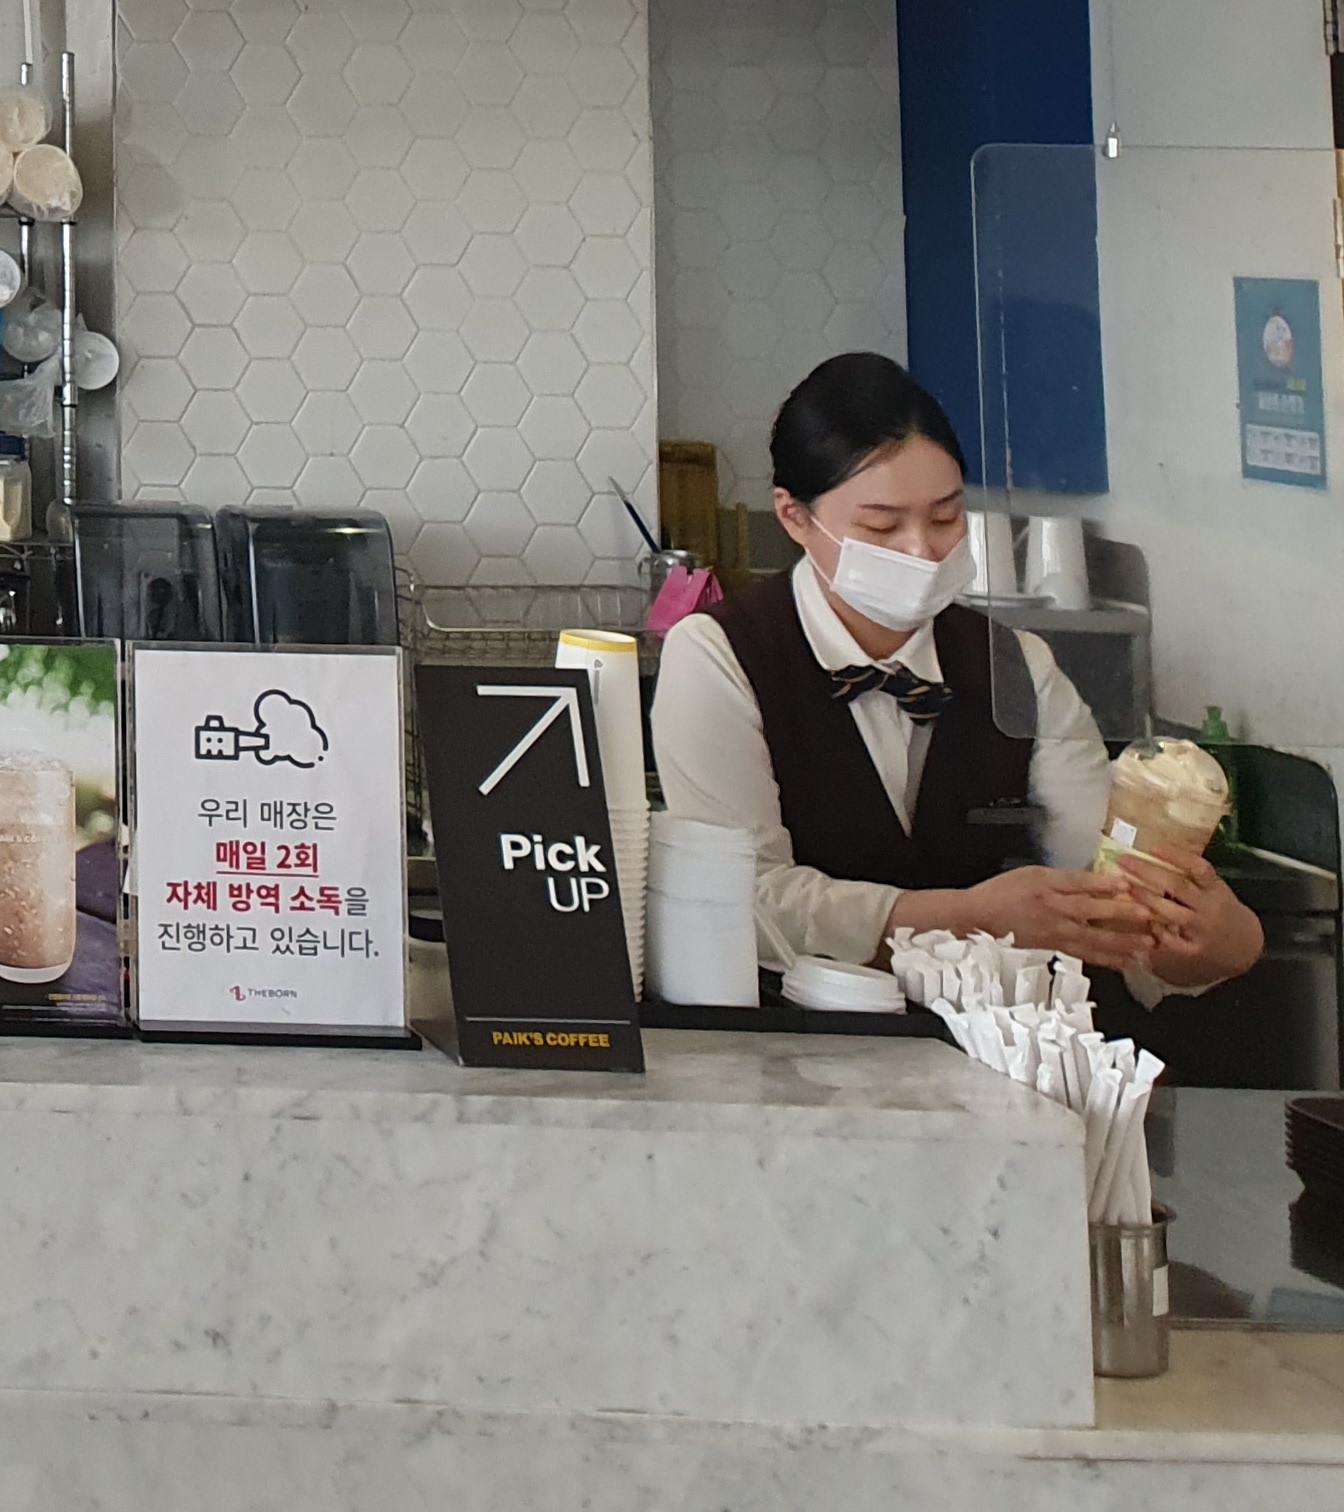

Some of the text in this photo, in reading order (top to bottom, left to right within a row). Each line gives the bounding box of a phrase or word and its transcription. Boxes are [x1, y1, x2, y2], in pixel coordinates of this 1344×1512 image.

[198, 798, 336, 831] 우리 매장은
[216, 841, 318, 872] 매일 2회
[499, 834, 606, 872] Pick
[166, 881, 369, 916] 자체 방역 소독을
[548, 876, 609, 912] UP
[157, 922, 379, 958] 진행하고 있습니다.
[248, 989, 297, 998] THEBORN
[492, 1031, 610, 1047] PAIK'S COFFEE
